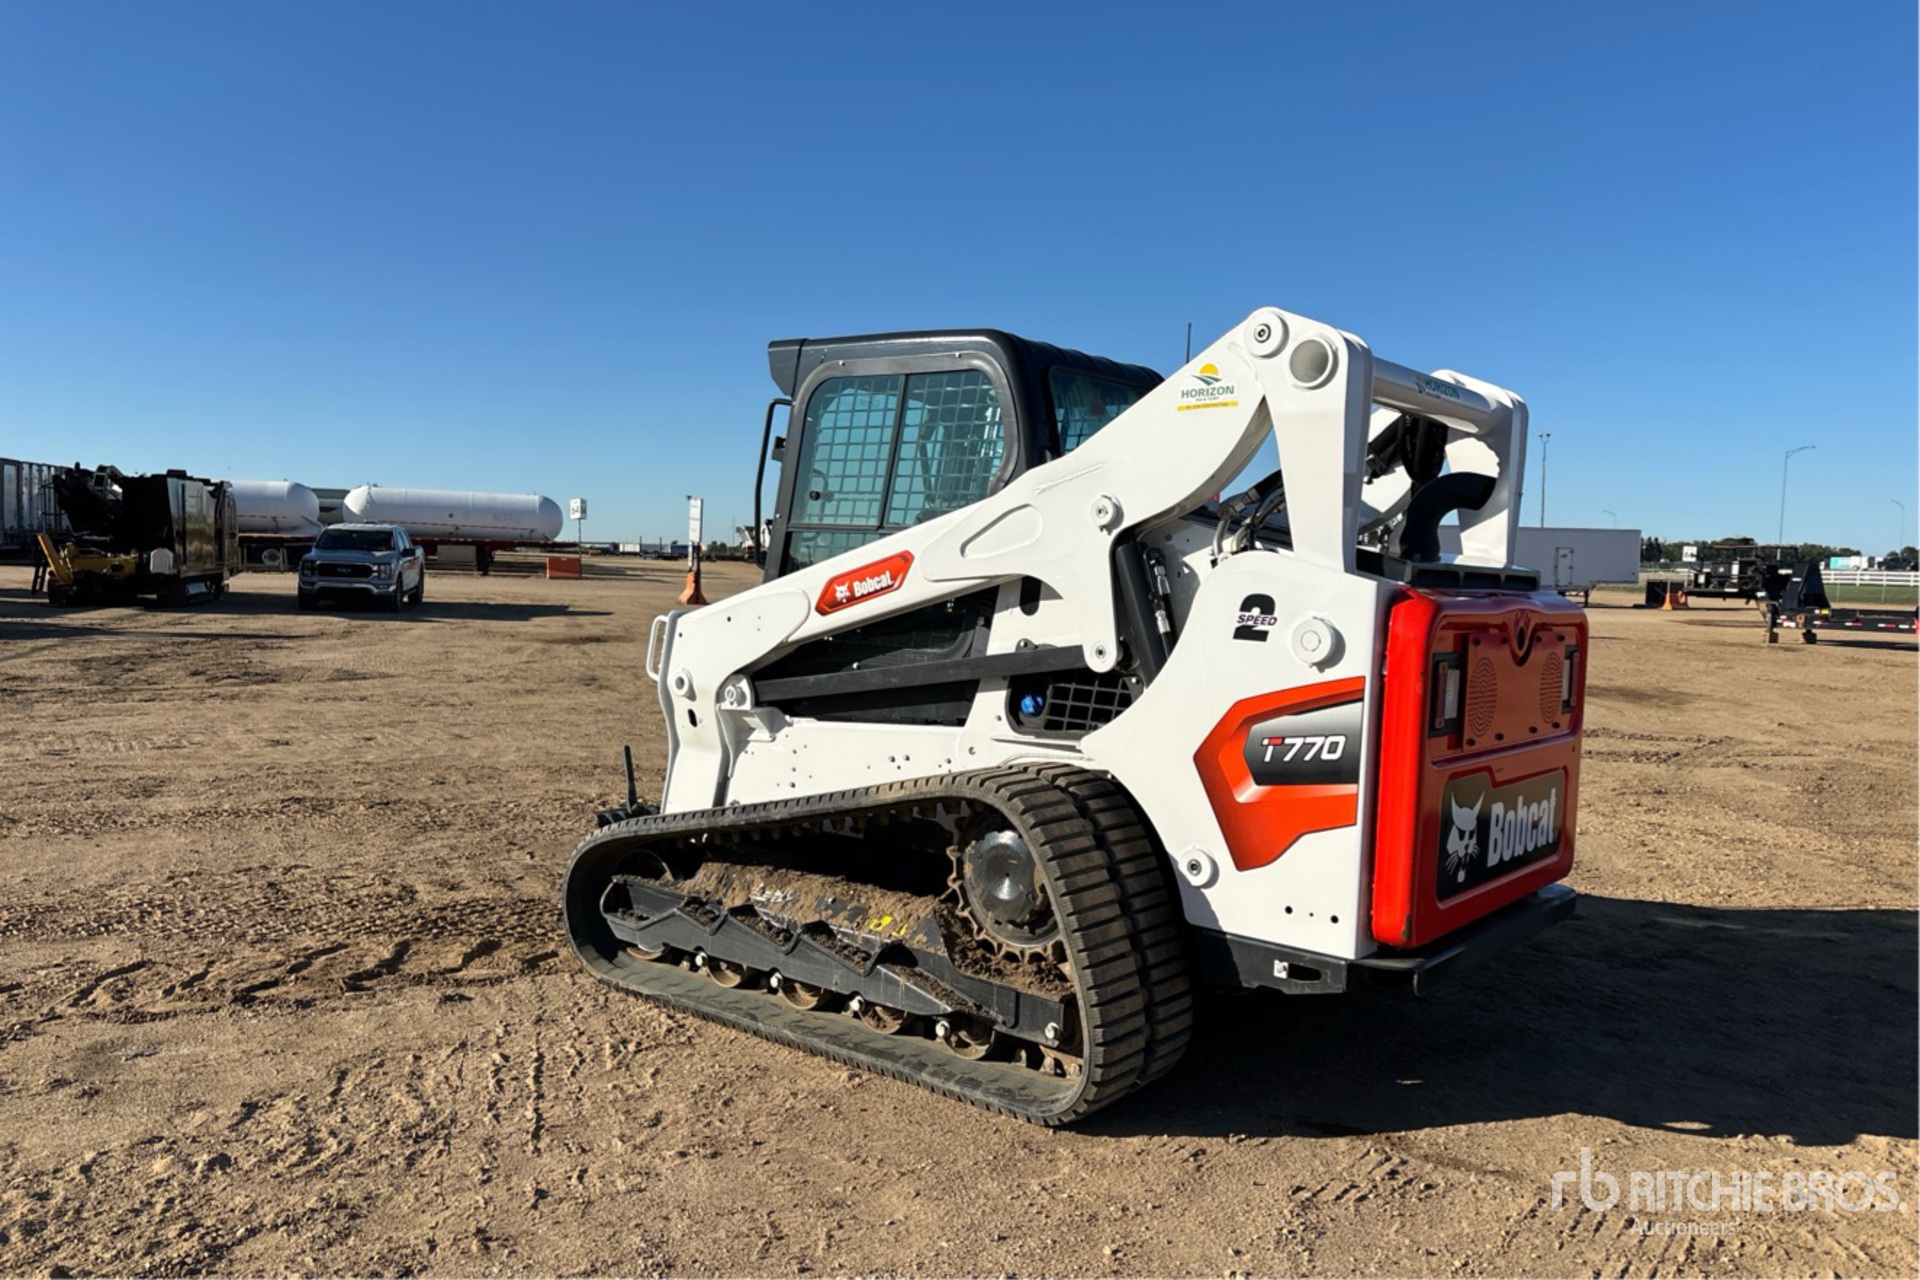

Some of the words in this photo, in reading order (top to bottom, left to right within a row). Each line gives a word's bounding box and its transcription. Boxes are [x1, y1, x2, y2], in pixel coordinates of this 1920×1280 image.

[1181, 385, 1235, 398] HORIZON
[852, 570, 892, 598] Bobcat
[1232, 593, 1276, 642] 2
[1237, 614, 1278, 626] SPEED
[1261, 734, 1347, 763] T770
[1487, 787, 1556, 868] Bobcat
